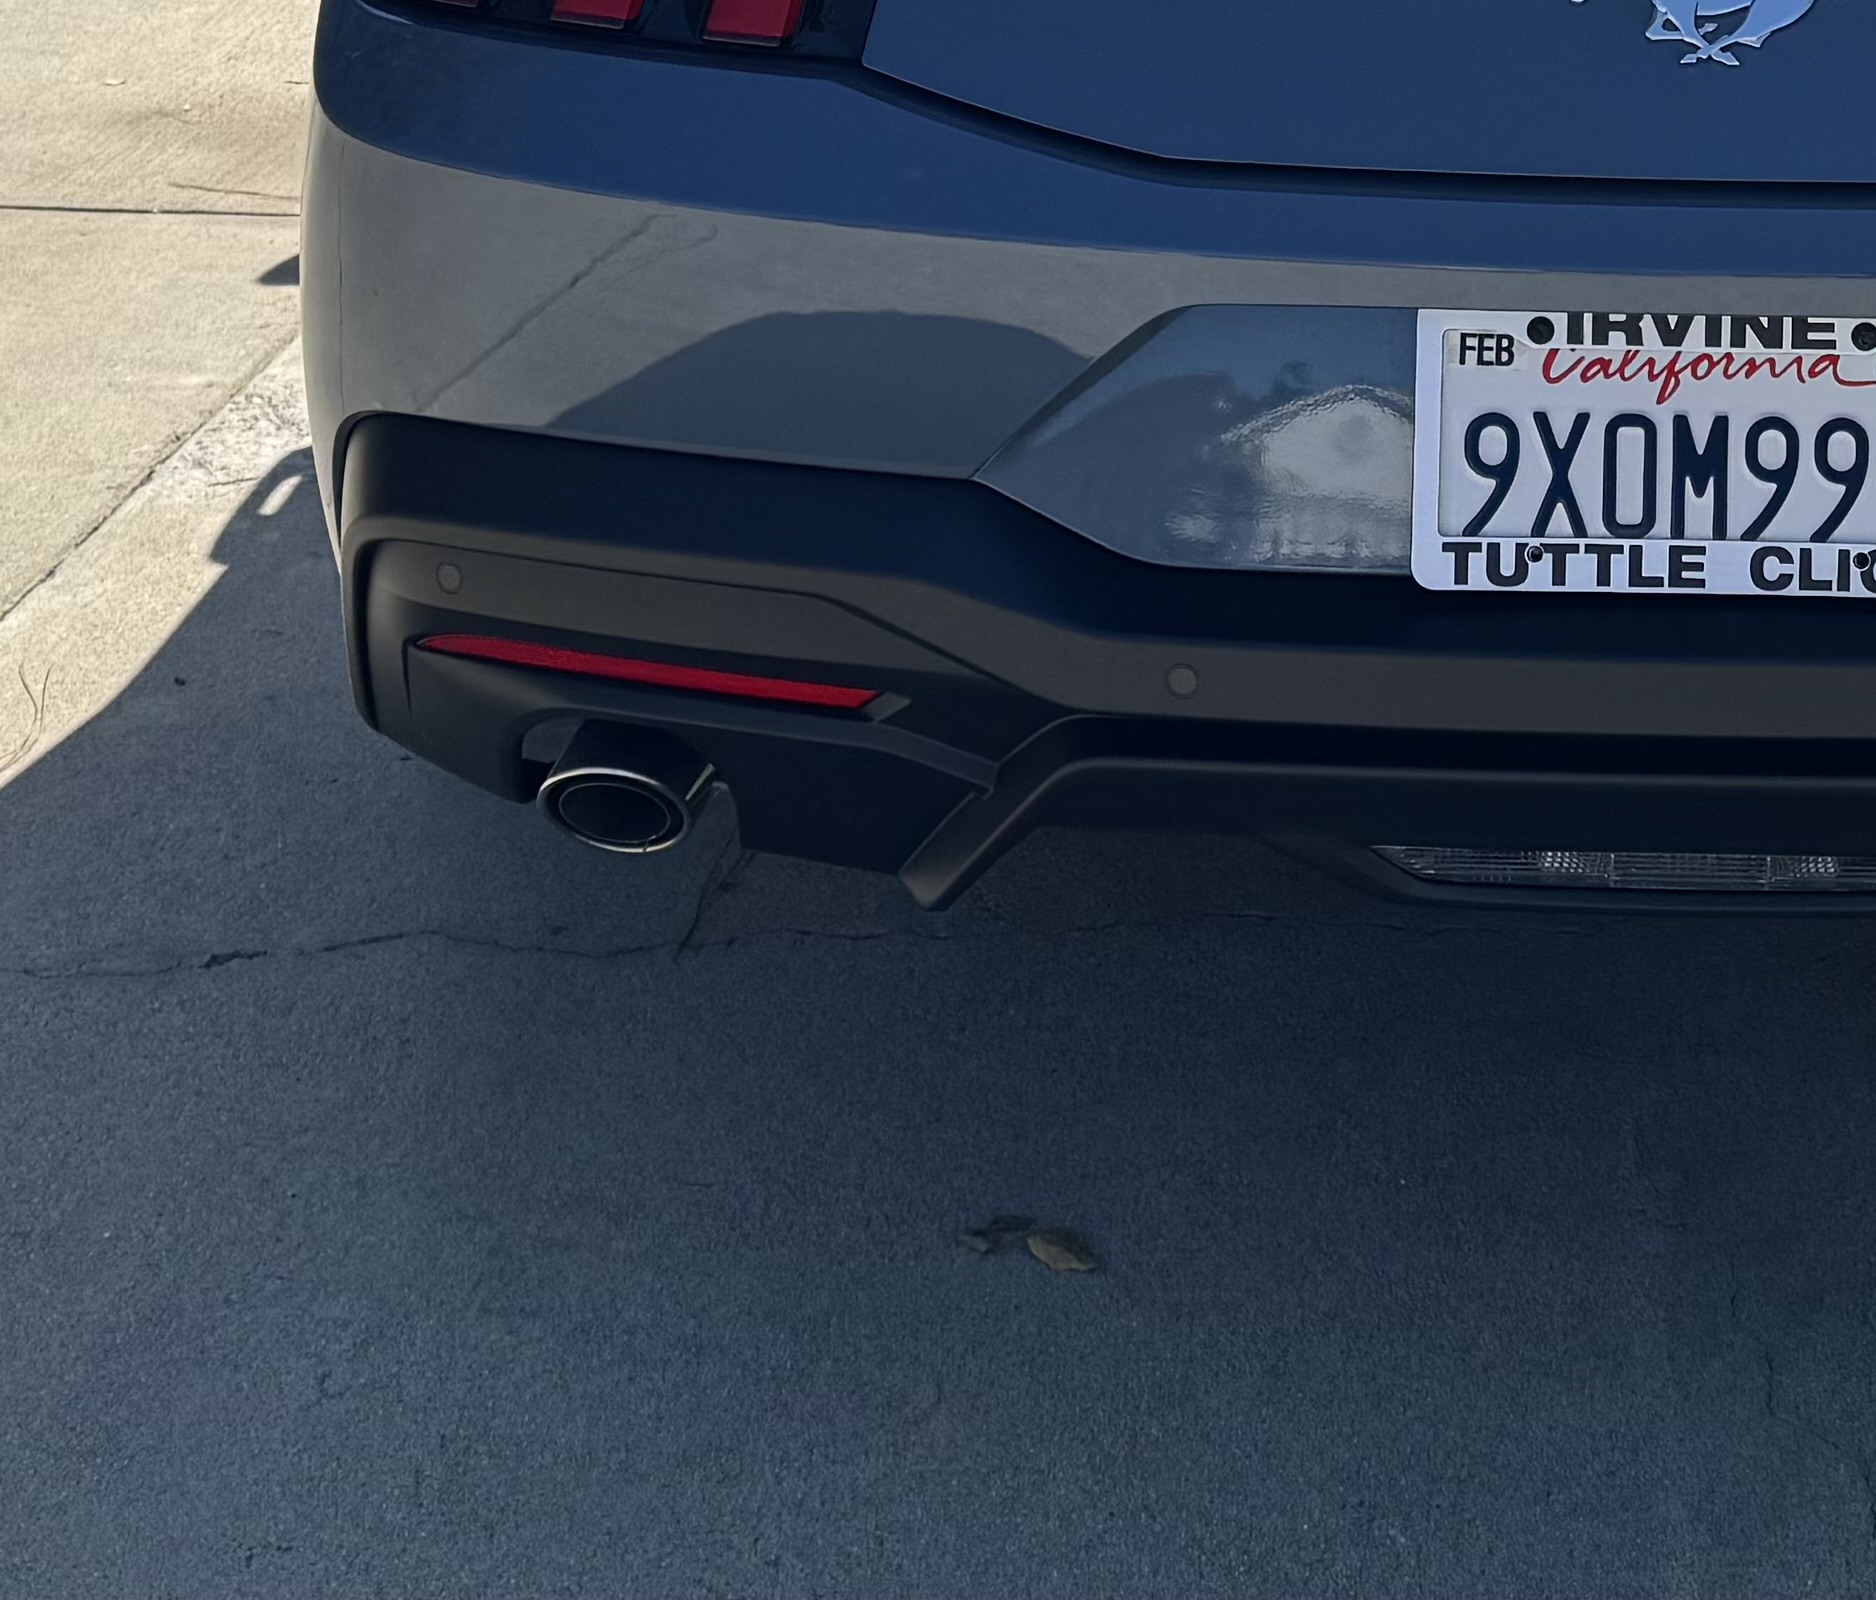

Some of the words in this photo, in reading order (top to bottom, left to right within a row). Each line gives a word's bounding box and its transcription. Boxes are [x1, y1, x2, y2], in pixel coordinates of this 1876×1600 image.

[1459, 332, 1515, 366] FEB
[1566, 312, 1837, 349] IRVINE
[1442, 542, 1707, 588] TUTTLE
